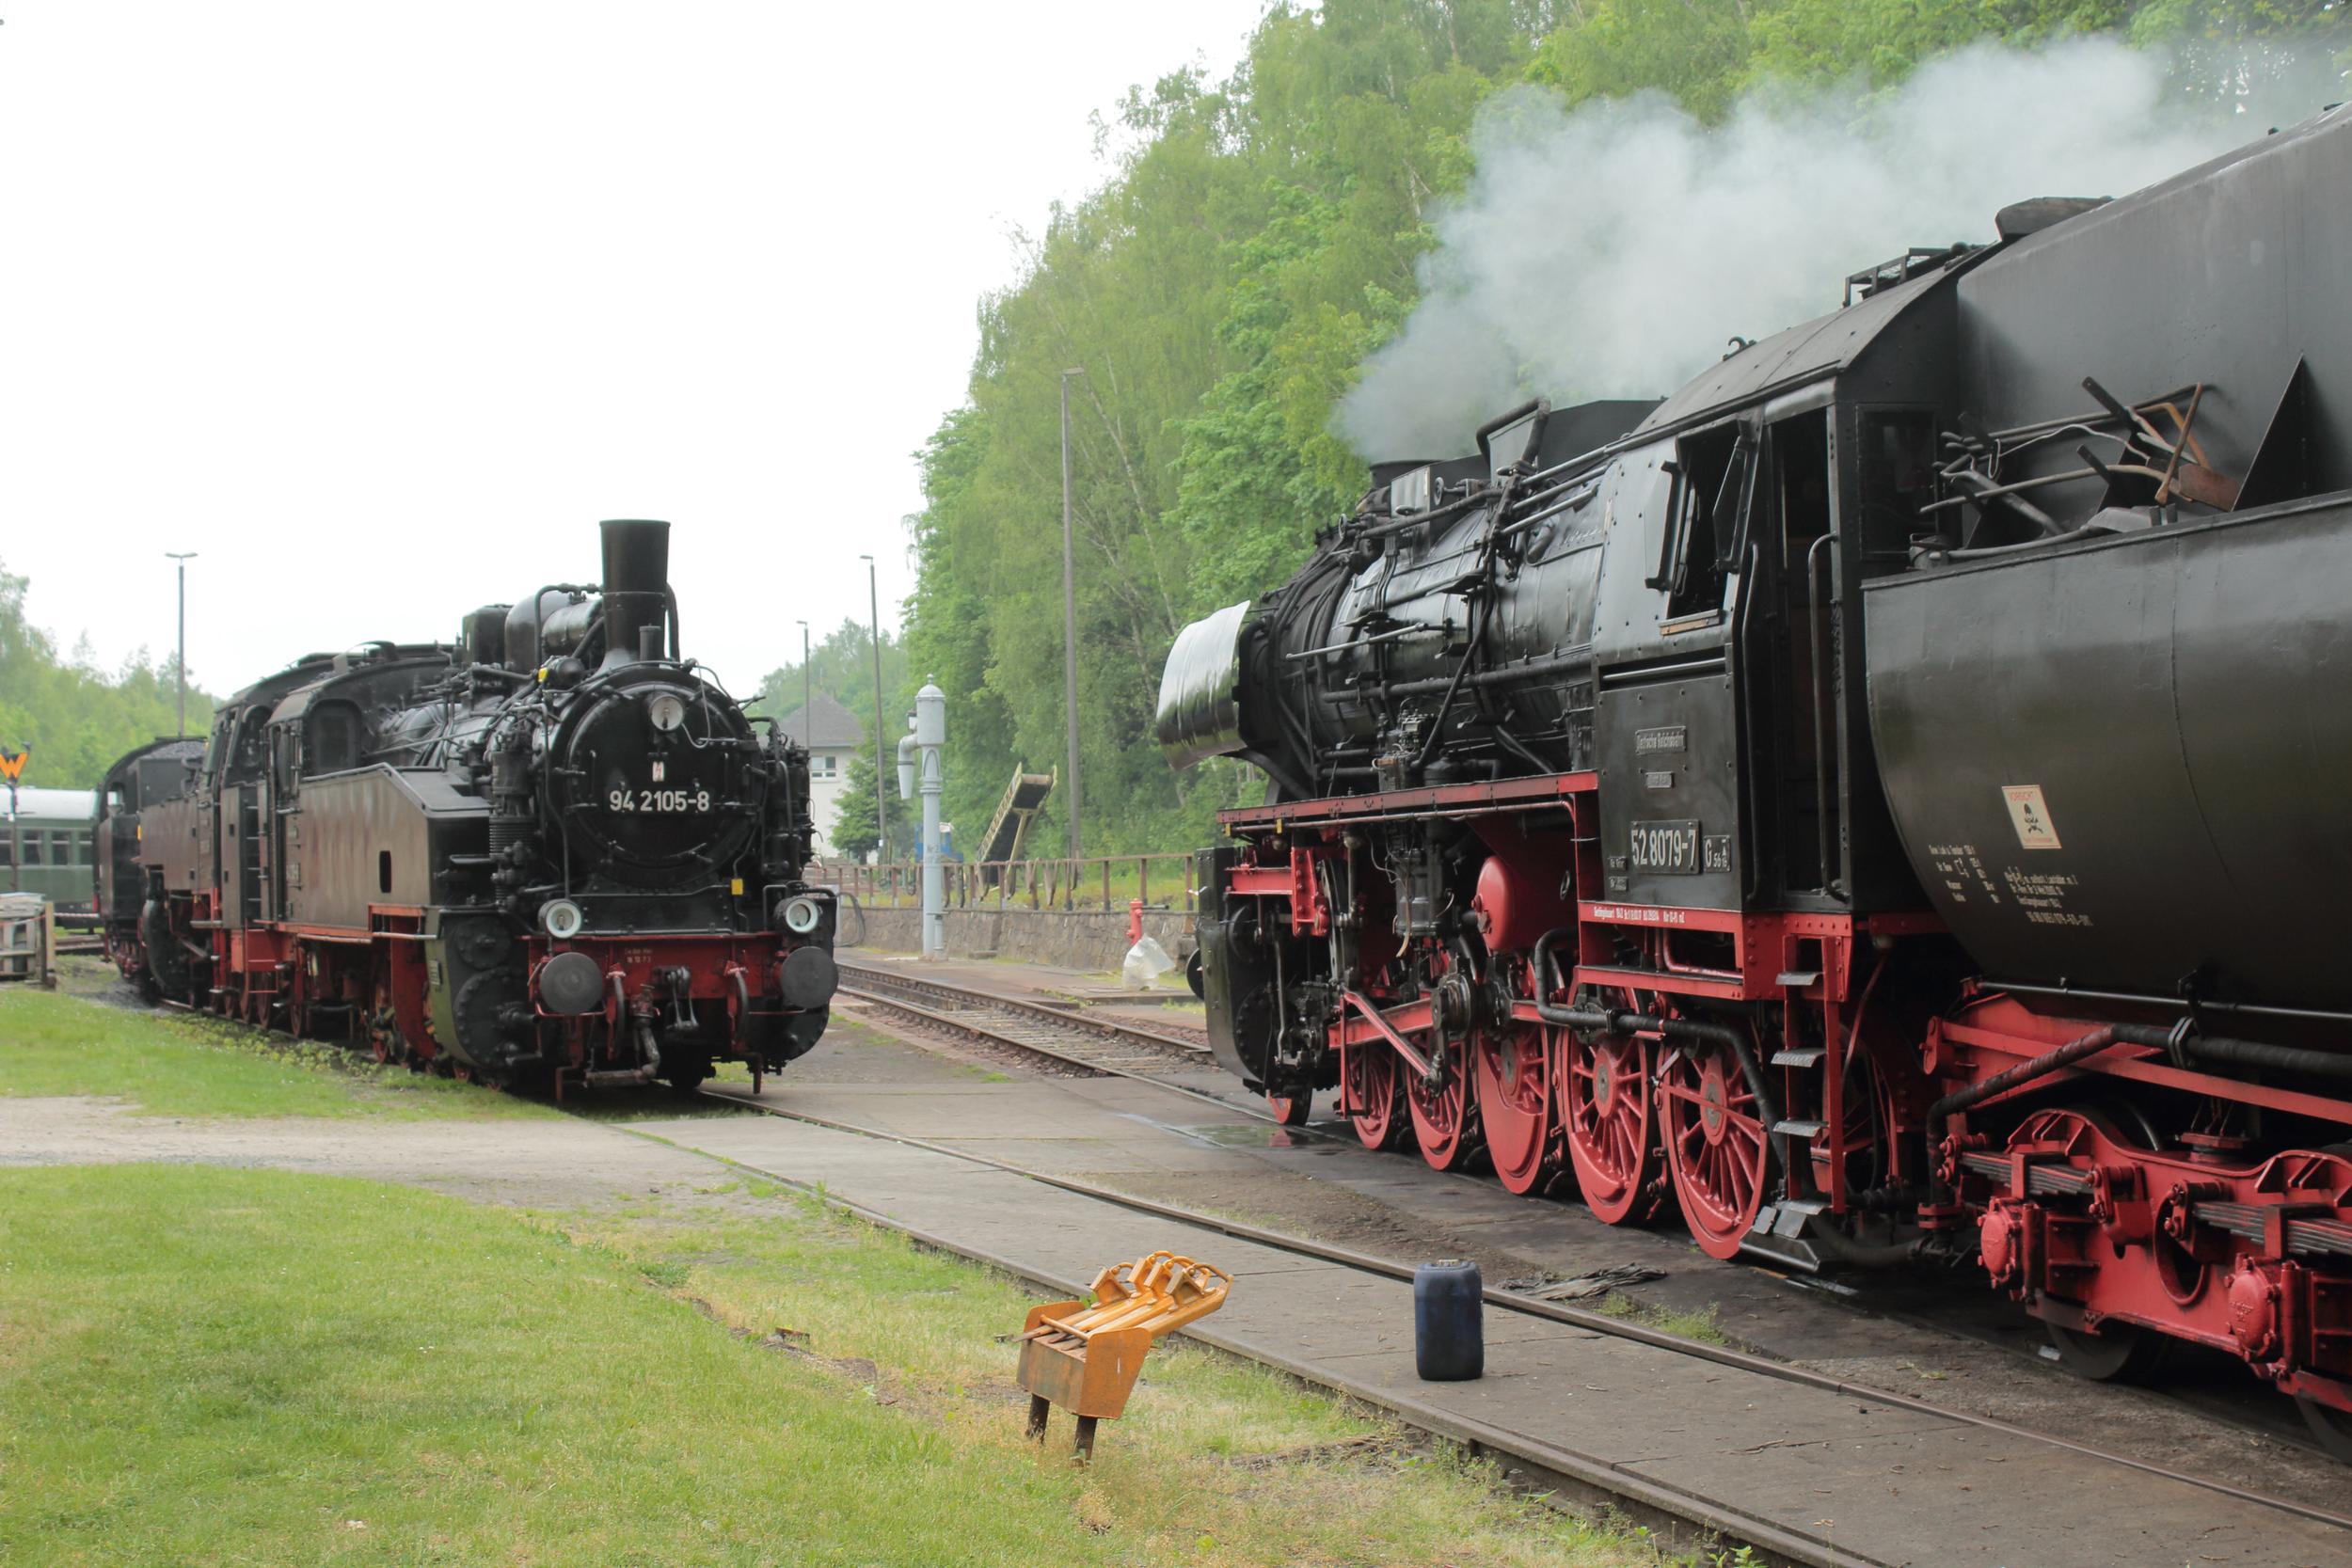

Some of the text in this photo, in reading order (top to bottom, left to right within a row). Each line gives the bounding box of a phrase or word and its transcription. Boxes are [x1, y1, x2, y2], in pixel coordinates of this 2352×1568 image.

[0, 752, 28, 779] W
[609, 790, 709, 811] 94 2105-8
[1631, 829, 1696, 866] 52 8079-7
[1705, 838, 1712, 867] G
